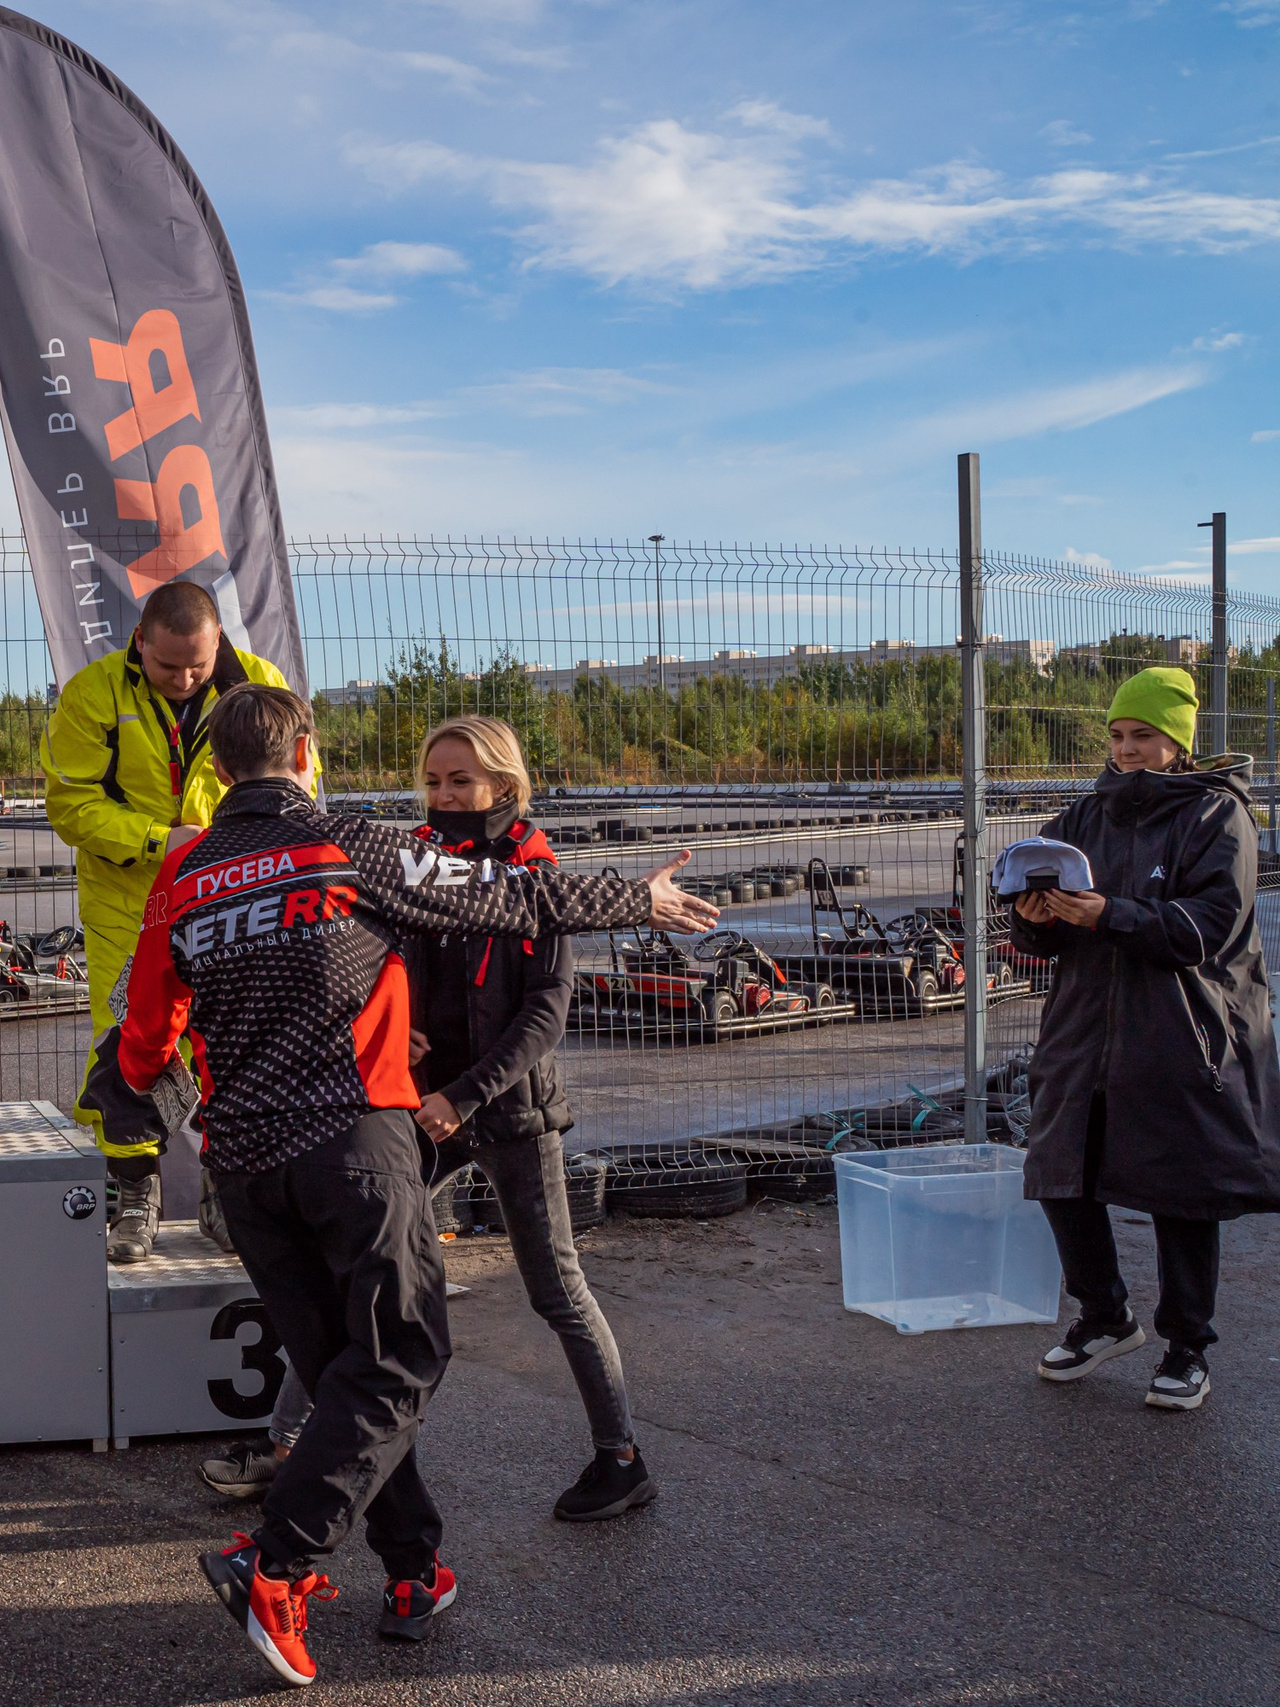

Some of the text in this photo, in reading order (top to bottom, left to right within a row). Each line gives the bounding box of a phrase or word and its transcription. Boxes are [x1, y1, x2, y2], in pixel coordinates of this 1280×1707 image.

[196, 852, 296, 899] ГУСЕВА
[171, 885, 359, 961] VETERR
[192, 919, 357, 972] ИЦИАЛЬНЫЙ ДИЛЕР
[76, 1203, 96, 1211] BRP
[206, 1297, 288, 1420] 3
